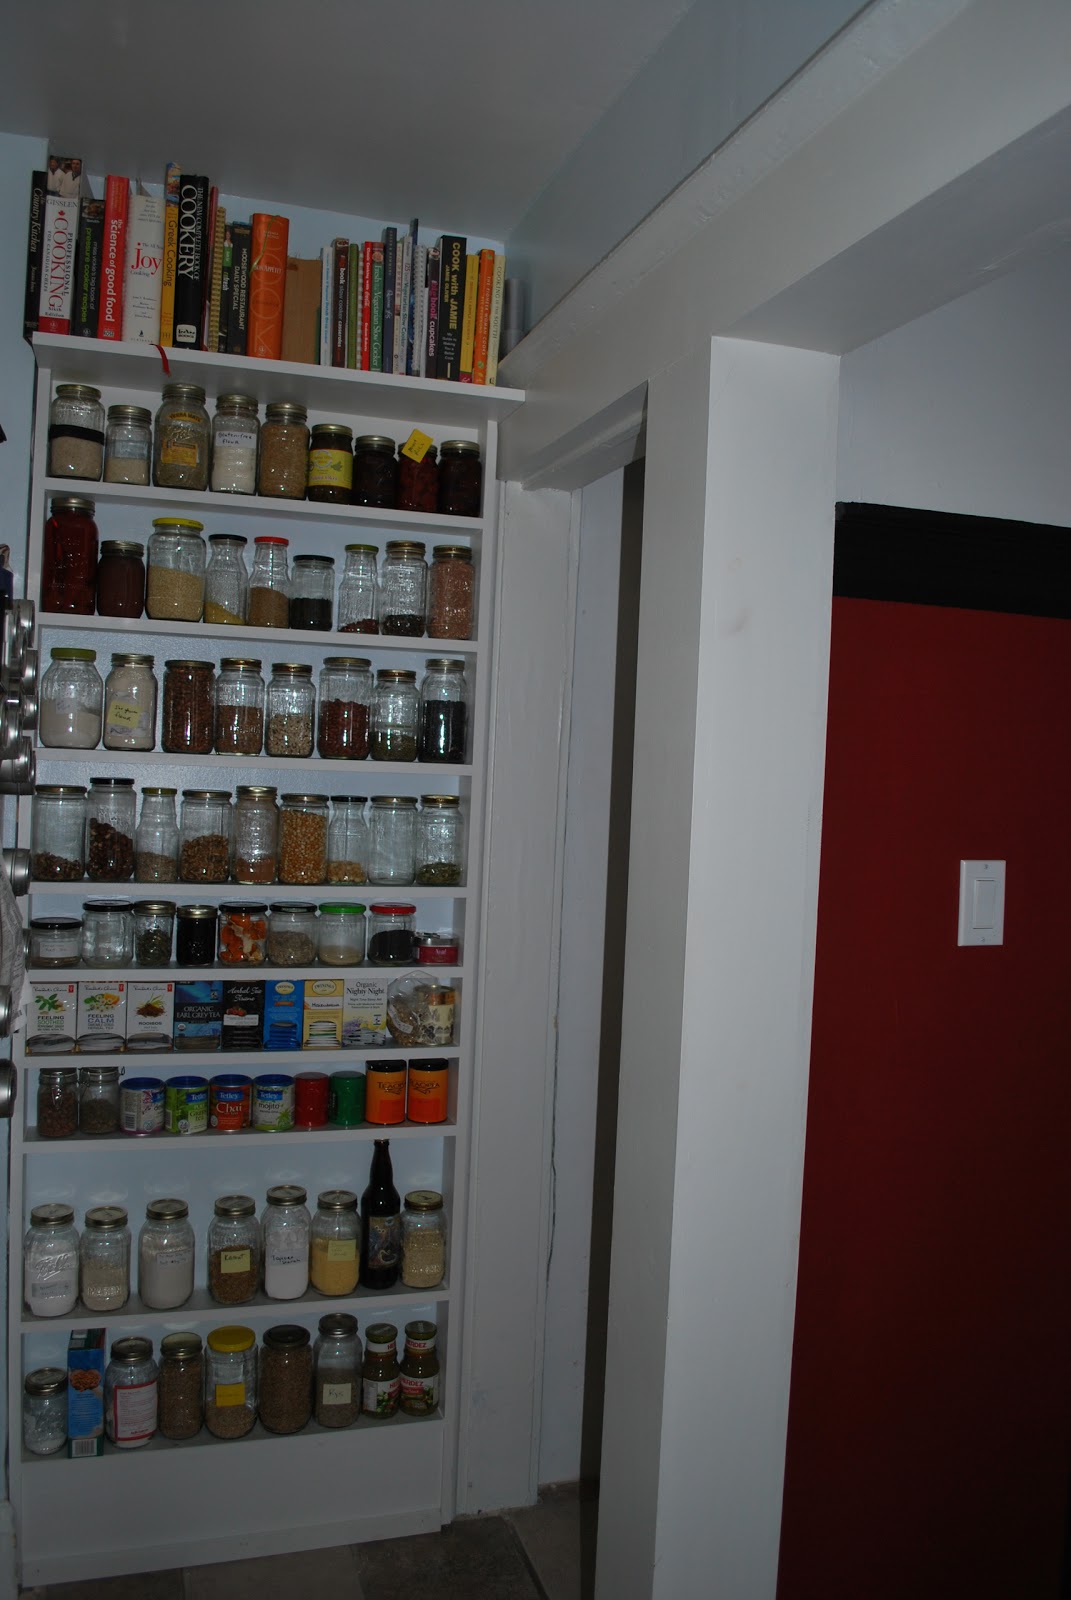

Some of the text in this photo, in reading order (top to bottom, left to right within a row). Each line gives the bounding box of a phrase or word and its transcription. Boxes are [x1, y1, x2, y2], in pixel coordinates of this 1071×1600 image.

[31, 188, 43, 221] Country
[30, 221, 41, 253] Kitchen
[84, 228, 92, 262] pressure
[109, 219, 120, 258] science
[178, 184, 197, 280] COOKERY
[48, 217, 69, 308] COOKING
[64, 232, 73, 297] PROFESSIONAL
[109, 259, 116, 268] of
[131, 242, 162, 275] joy
[163, 220, 178, 287] Greek Cooking
[451, 242, 461, 272] COOK
[106, 268, 117, 295] good
[81, 293, 89, 323] recipes
[106, 297, 116, 322] food
[372, 291, 381, 325] Vegetarian
[449, 298, 458, 330] JAMIE
[347, 988, 366, 996] Nighty
[216, 1102, 242, 1113] Chai
[328, 1389, 344, 1398] Rye
